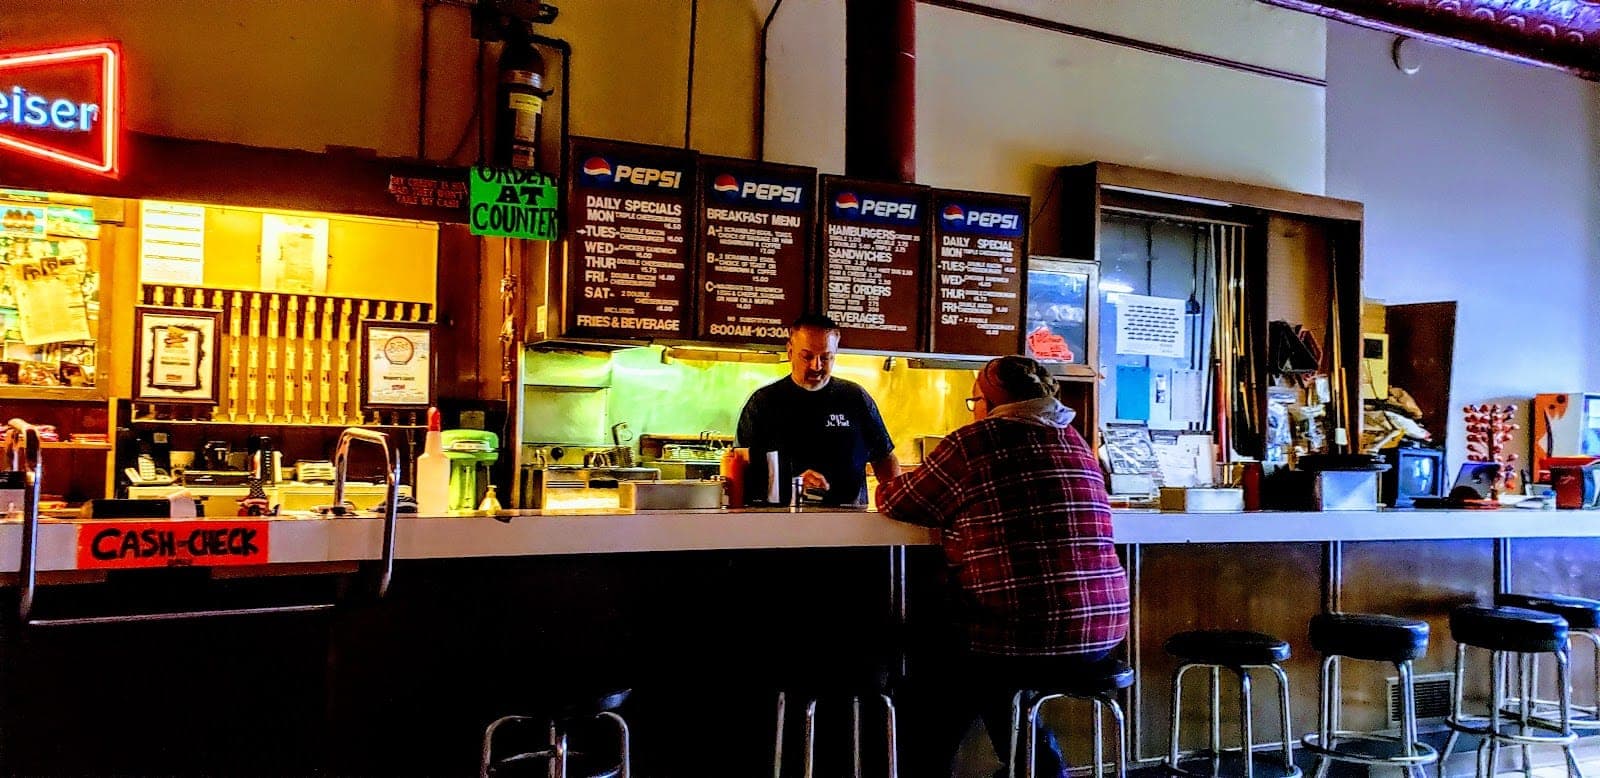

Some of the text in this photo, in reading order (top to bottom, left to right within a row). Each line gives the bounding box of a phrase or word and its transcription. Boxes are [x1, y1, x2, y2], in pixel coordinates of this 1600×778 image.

[614, 165, 682, 189] PEPSI
[496, 185, 545, 206] AT
[741, 181, 802, 204] PEPSI
[586, 195, 682, 216] DAILY SPECIALS
[861, 199, 917, 219] PEPSI
[473, 202, 558, 238] COUNTER
[586, 208, 615, 222] MON
[706, 207, 801, 228] BREAKFAST MENU
[966, 211, 1019, 229] PEPSI
[828, 223, 896, 241] HAMBURGERS
[941, 246, 962, 258] MON
[943, 236, 1014, 252] DAILY SPECIAL
[585, 256, 617, 269] THUR
[828, 247, 893, 263] SANDWICHES
[828, 282, 892, 297] SIDE ORDERS
[941, 288, 965, 299] THUR
[577, 315, 680, 331] FRIES & BEVERAGE
[92, 527, 258, 560] CASH-CHECK
